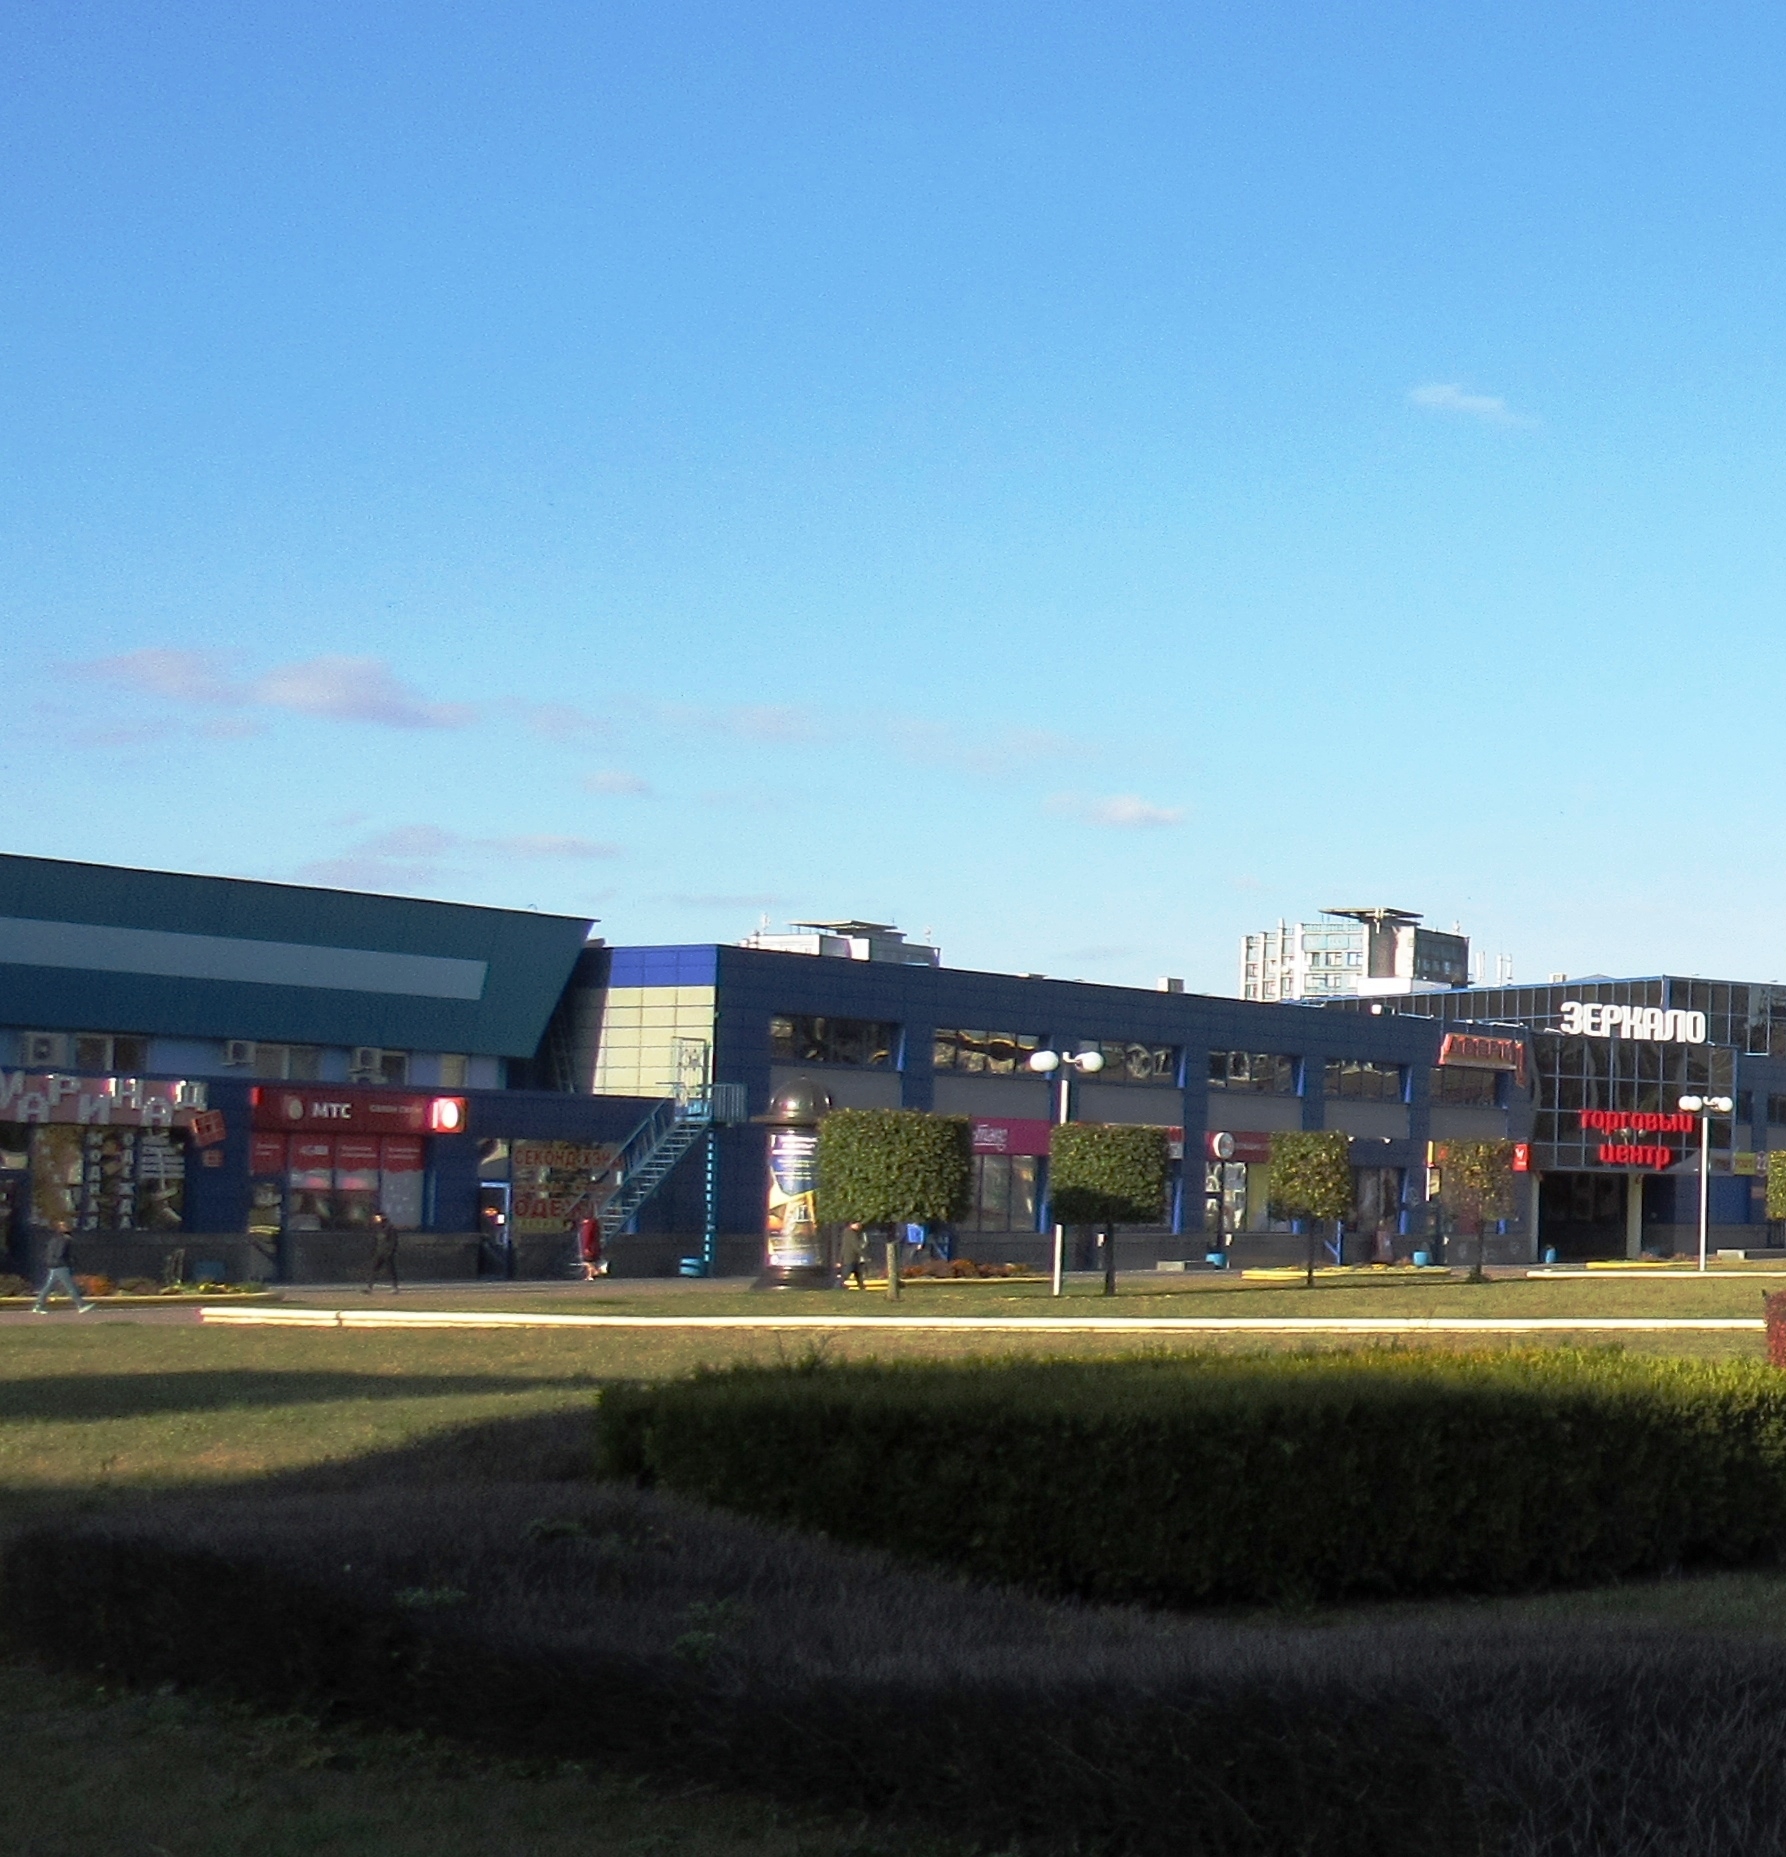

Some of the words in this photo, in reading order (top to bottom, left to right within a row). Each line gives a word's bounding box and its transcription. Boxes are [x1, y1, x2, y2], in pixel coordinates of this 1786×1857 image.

[1560, 1001, 1707, 1044] ЗЕРКАЛО
[312, 1102, 352, 1119] МТС
[1579, 1109, 1694, 1134] торговый
[1599, 1143, 1673, 1171] центр
